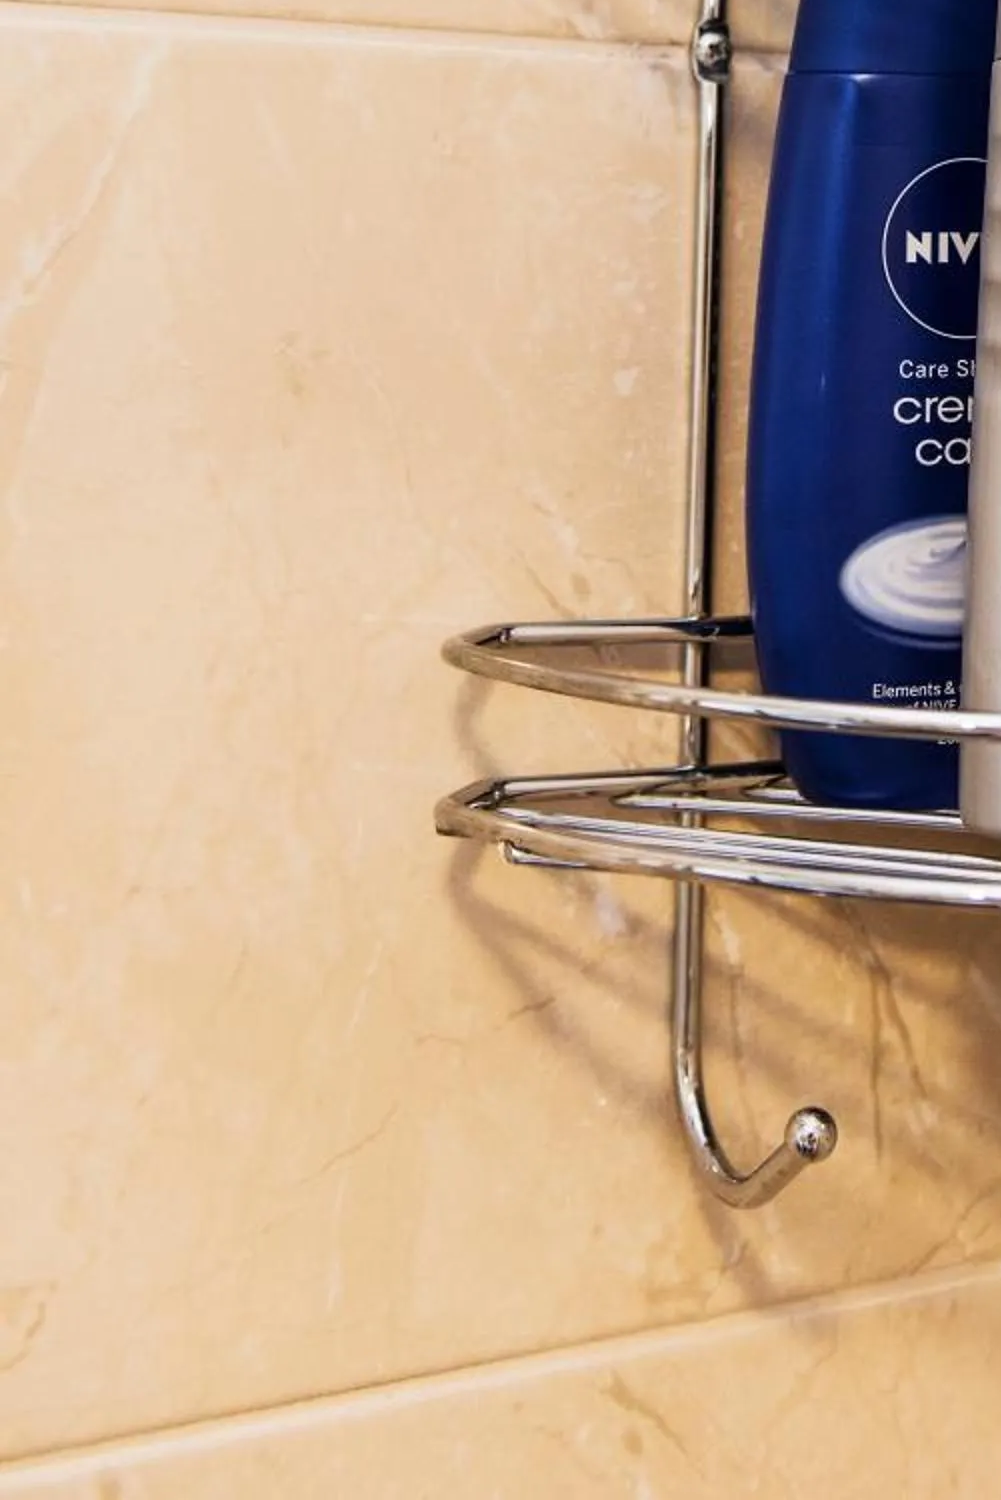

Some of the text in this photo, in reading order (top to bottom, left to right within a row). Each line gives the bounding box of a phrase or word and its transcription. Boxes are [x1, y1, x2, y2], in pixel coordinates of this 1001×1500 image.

[905, 230, 981, 265] NIV
[899, 359, 949, 379] Care
[872, 680, 956, 699] Elements &
